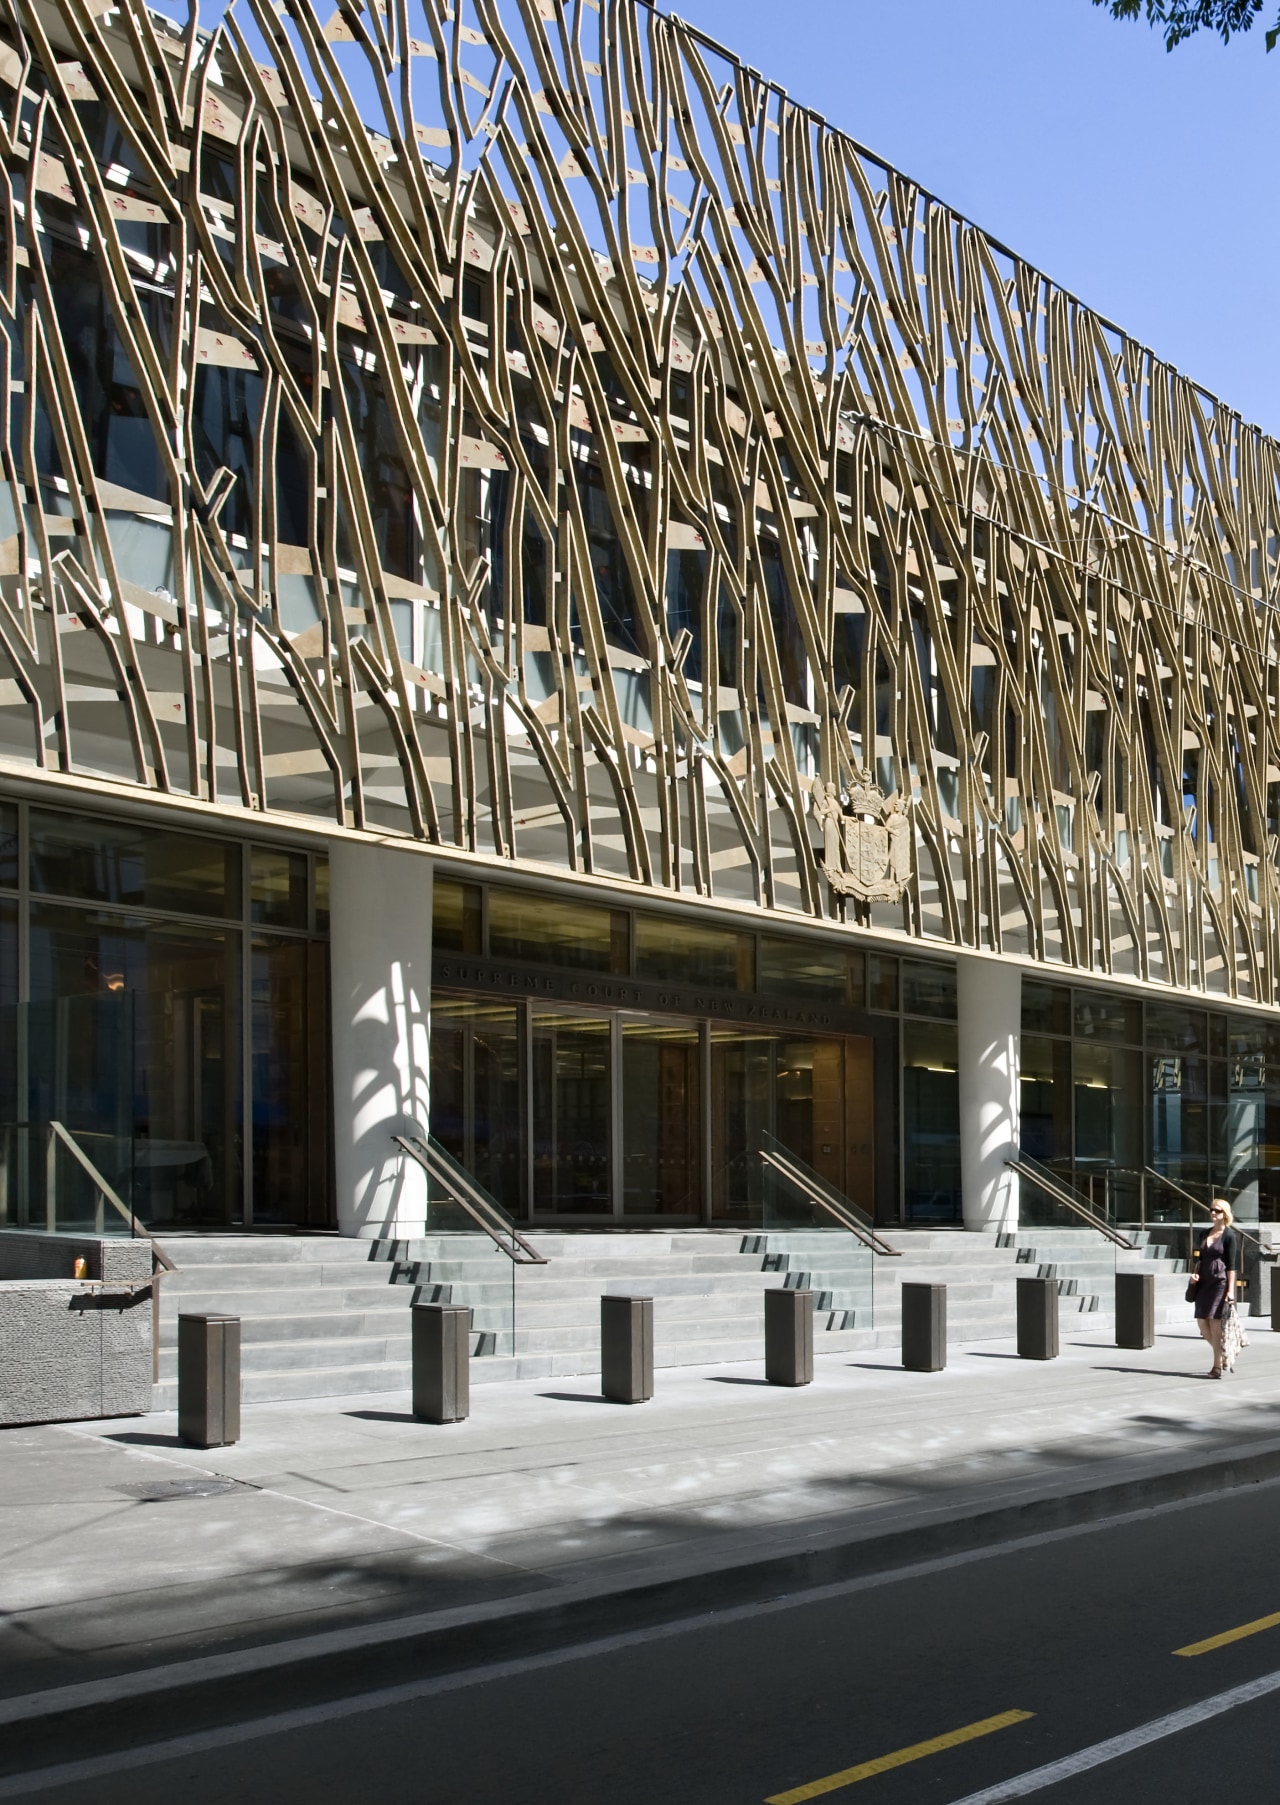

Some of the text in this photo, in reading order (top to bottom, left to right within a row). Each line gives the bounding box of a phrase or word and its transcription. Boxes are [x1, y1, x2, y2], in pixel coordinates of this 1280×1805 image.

[441, 964, 832, 1025] SUPREME COURT OF NEW ZEALAND
